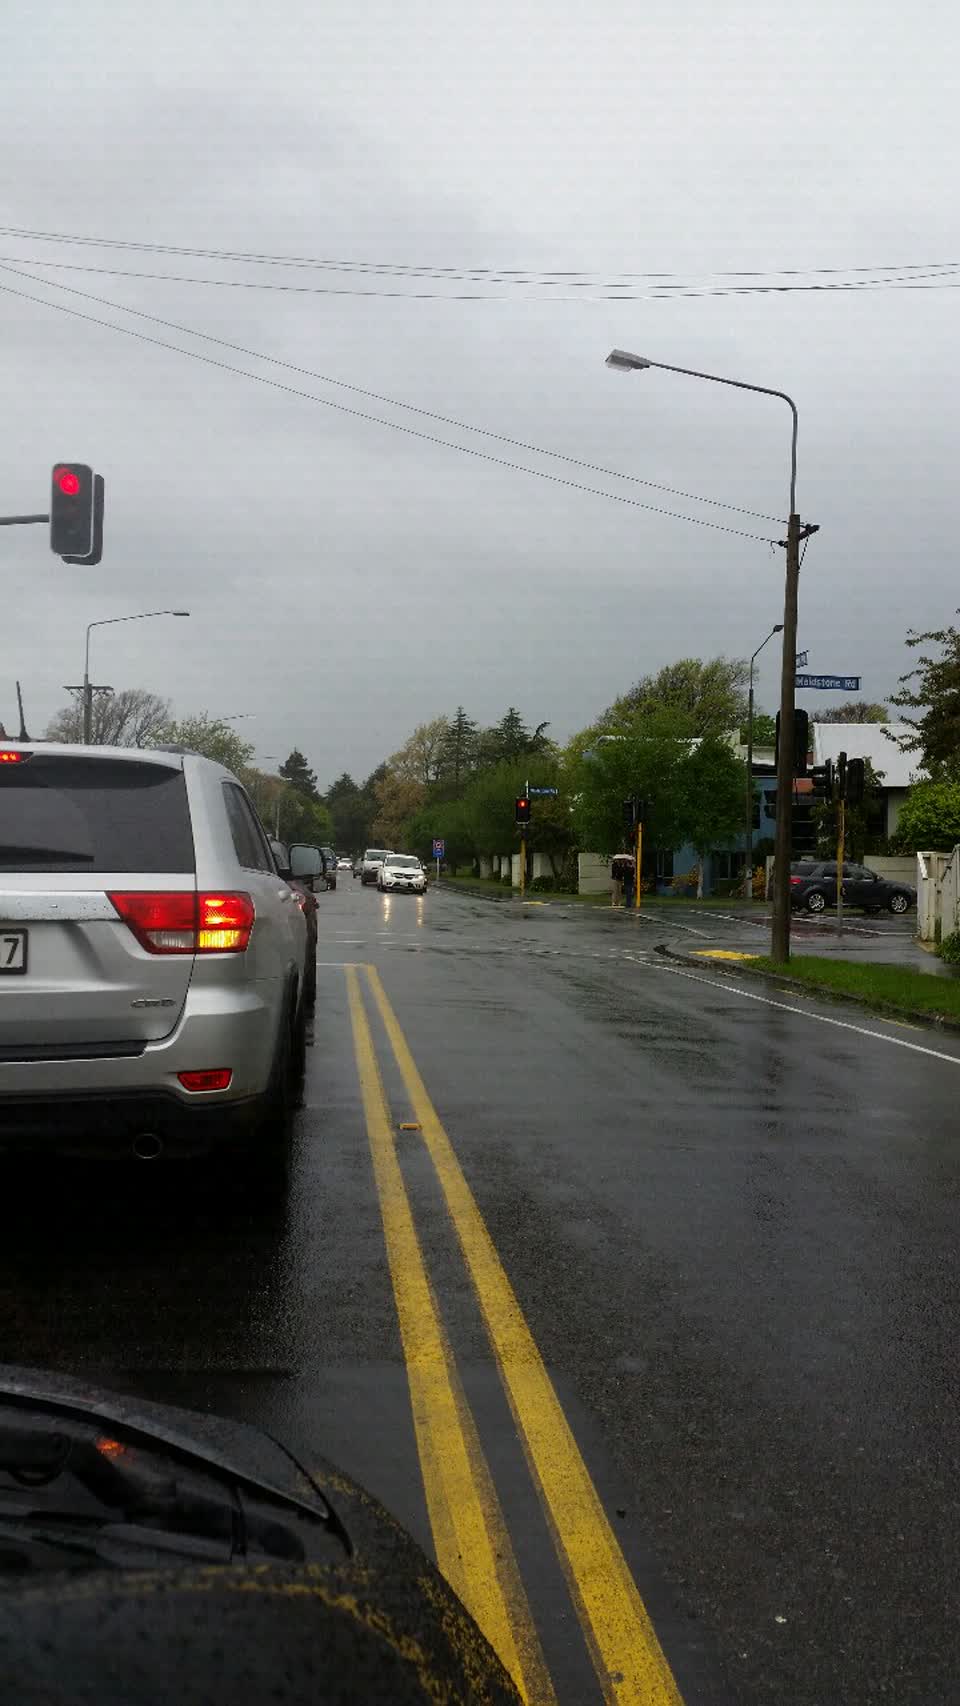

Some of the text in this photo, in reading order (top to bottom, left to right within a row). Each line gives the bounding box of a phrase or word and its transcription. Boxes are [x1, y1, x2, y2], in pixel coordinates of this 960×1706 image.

[796, 676, 857, 689] Maidstone Rd
[4, 938, 19, 964] 7
